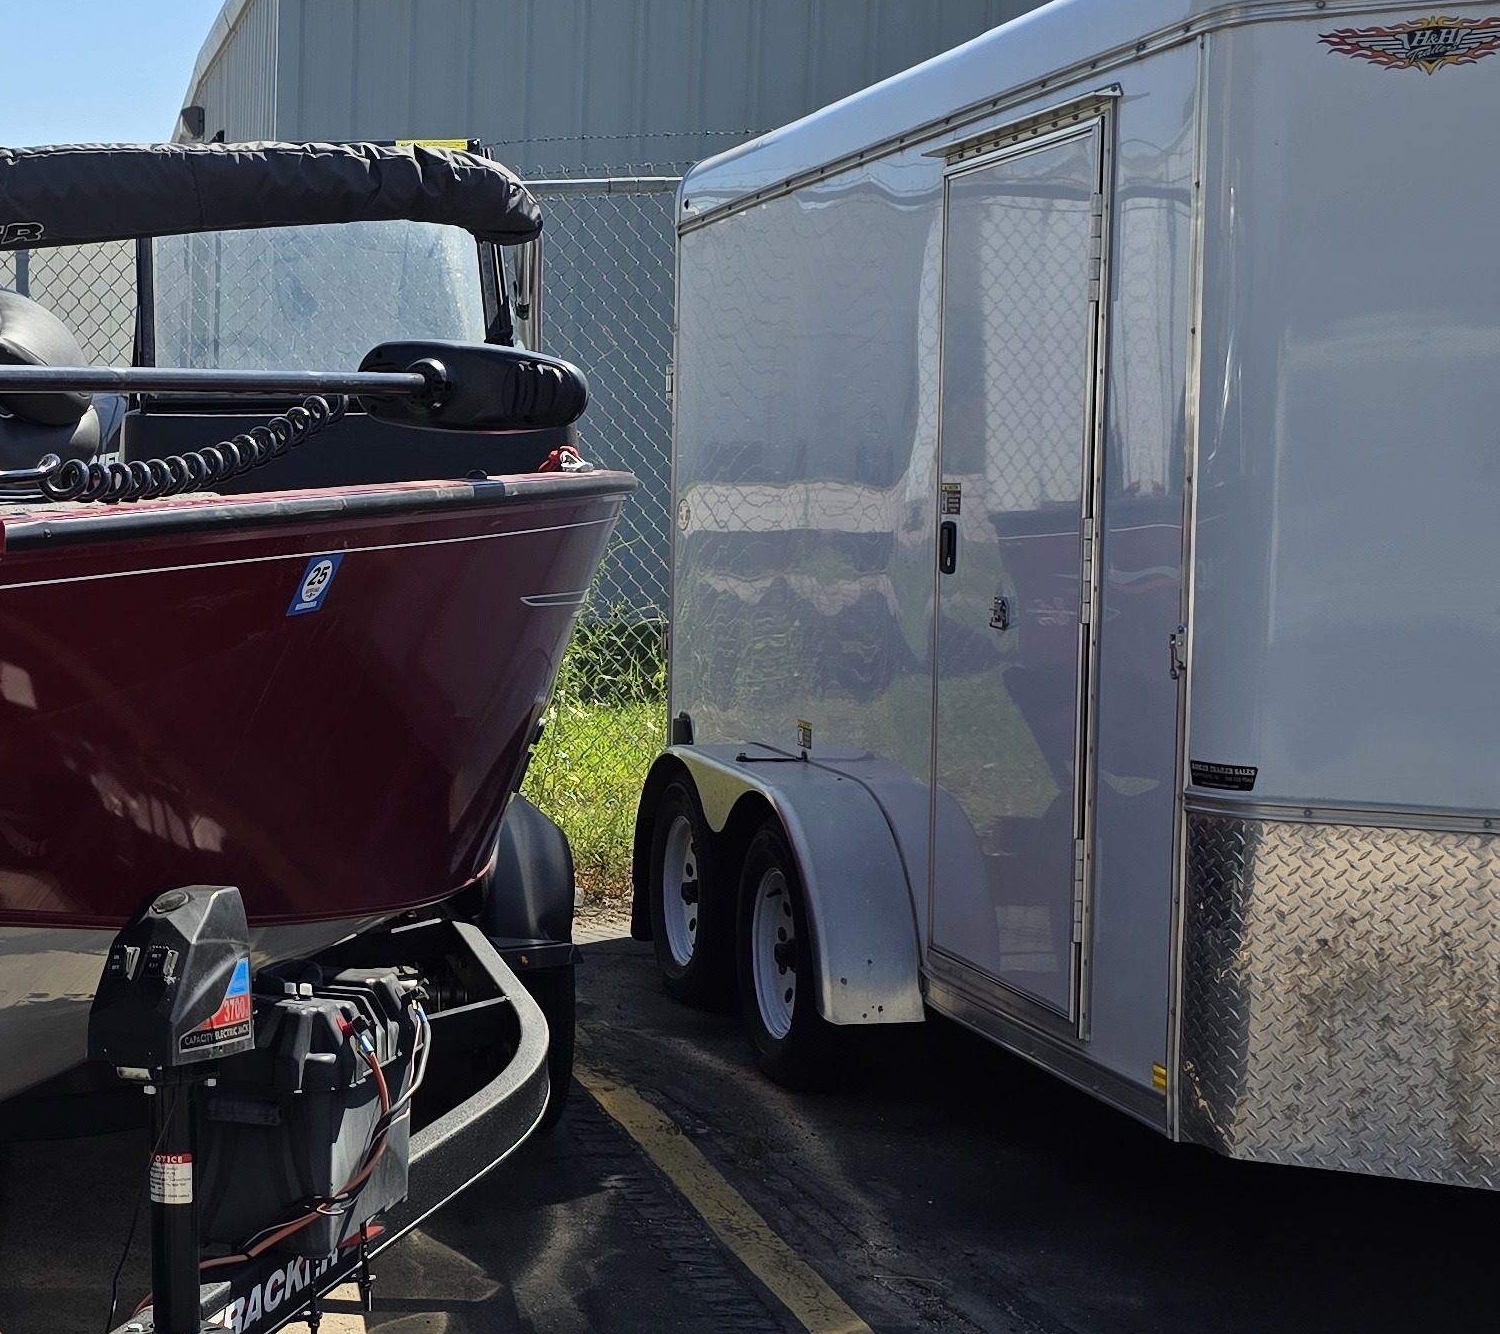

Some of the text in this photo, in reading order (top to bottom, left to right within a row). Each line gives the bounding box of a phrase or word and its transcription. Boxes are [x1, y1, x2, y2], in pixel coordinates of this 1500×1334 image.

[1410, 28, 1459, 46] H&H
[1406, 44, 1458, 63] Trailers
[307, 566, 331, 586] 25
[224, 997, 245, 1022] 3700
[184, 1023, 249, 1046] CAPACITY ELECTRIC JACK
[155, 1154, 183, 1163] OTICE
